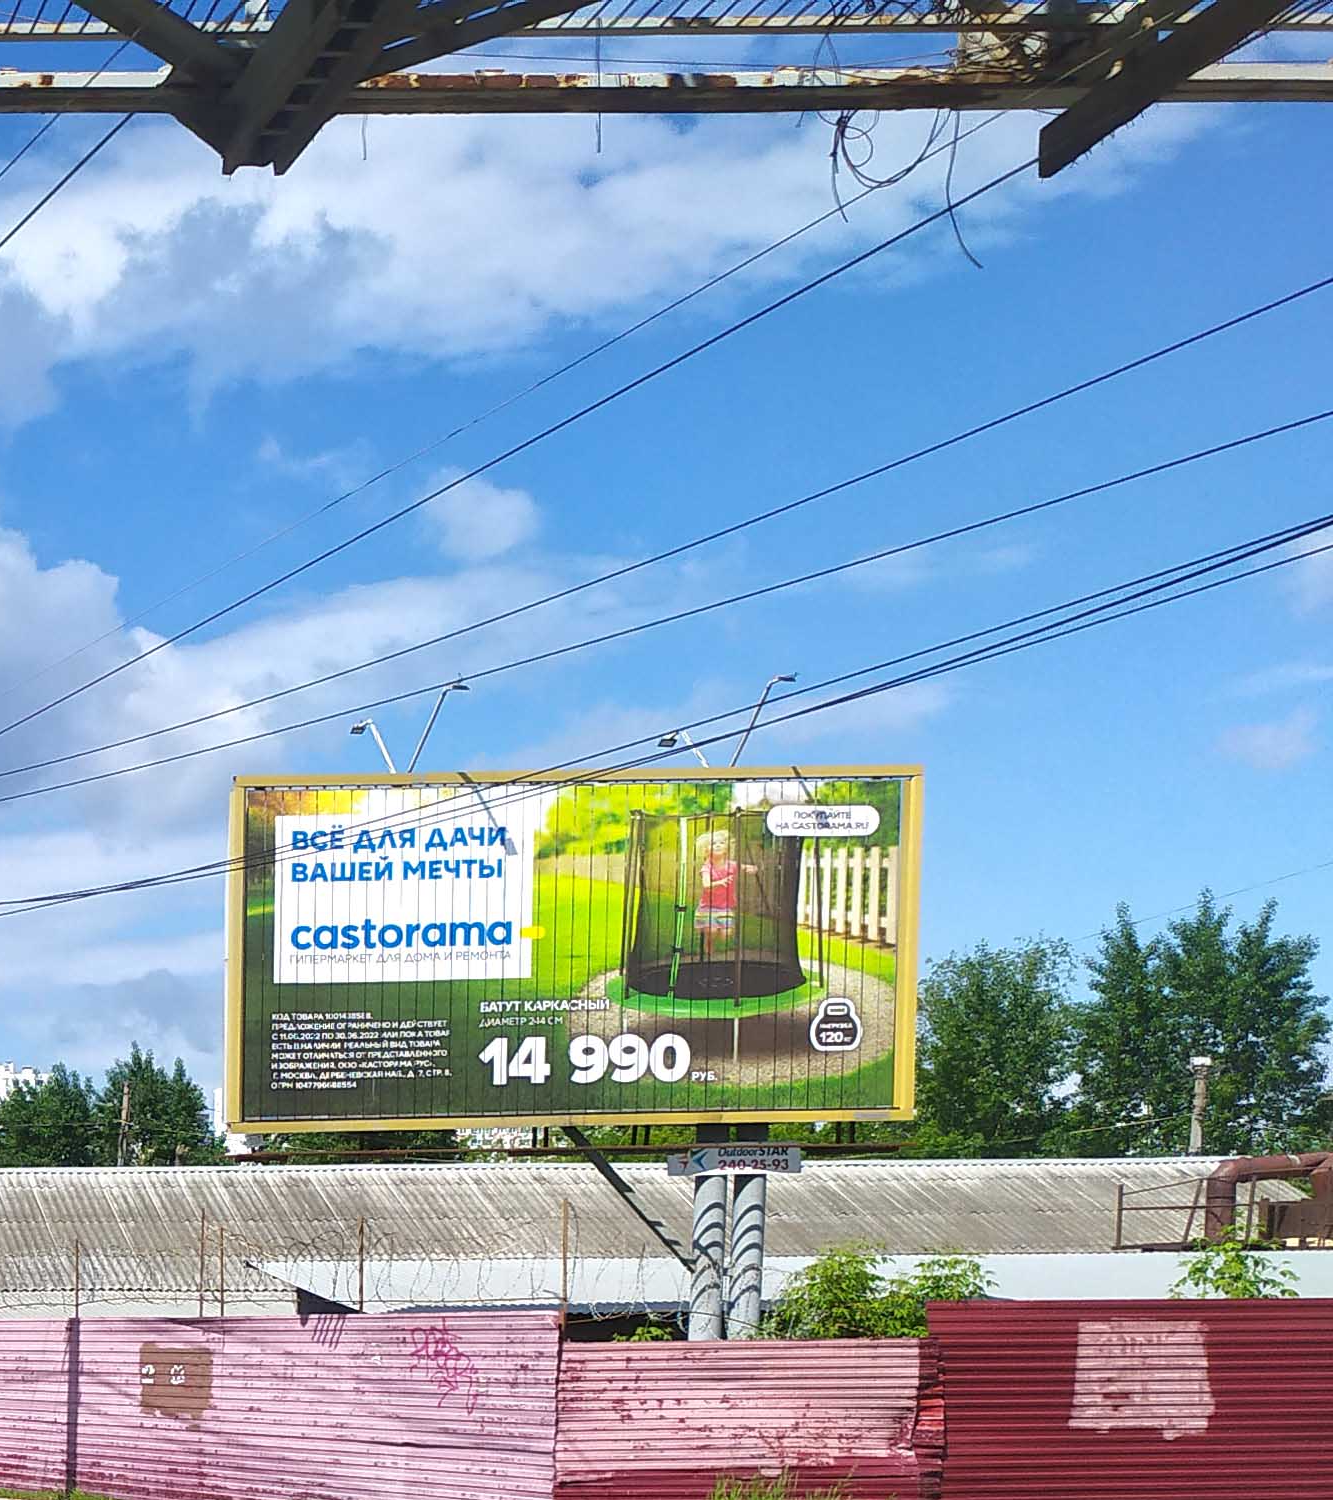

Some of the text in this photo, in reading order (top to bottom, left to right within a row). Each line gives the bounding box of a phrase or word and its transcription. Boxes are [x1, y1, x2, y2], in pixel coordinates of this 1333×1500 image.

[291, 825, 507, 853] ВСЁ ДЛЯ ДАЧИ
[290, 856, 503, 882] ВАШЕЙ МЕЧТЫ
[290, 918, 513, 950] castorama
[289, 950, 512, 965] ГИПЕРМАРКЕТ ДЛЯ ДОМА И РЕМОНТА
[479, 997, 610, 1013] БАТУТ КАРКАСНЫЙ
[819, 1031, 844, 1043] 120
[478, 1036, 551, 1086] 14
[568, 1033, 691, 1084] 990
[717, 1146, 789, 1158] OutdoorSTAR
[717, 1158, 790, 1171] 240-25-93
